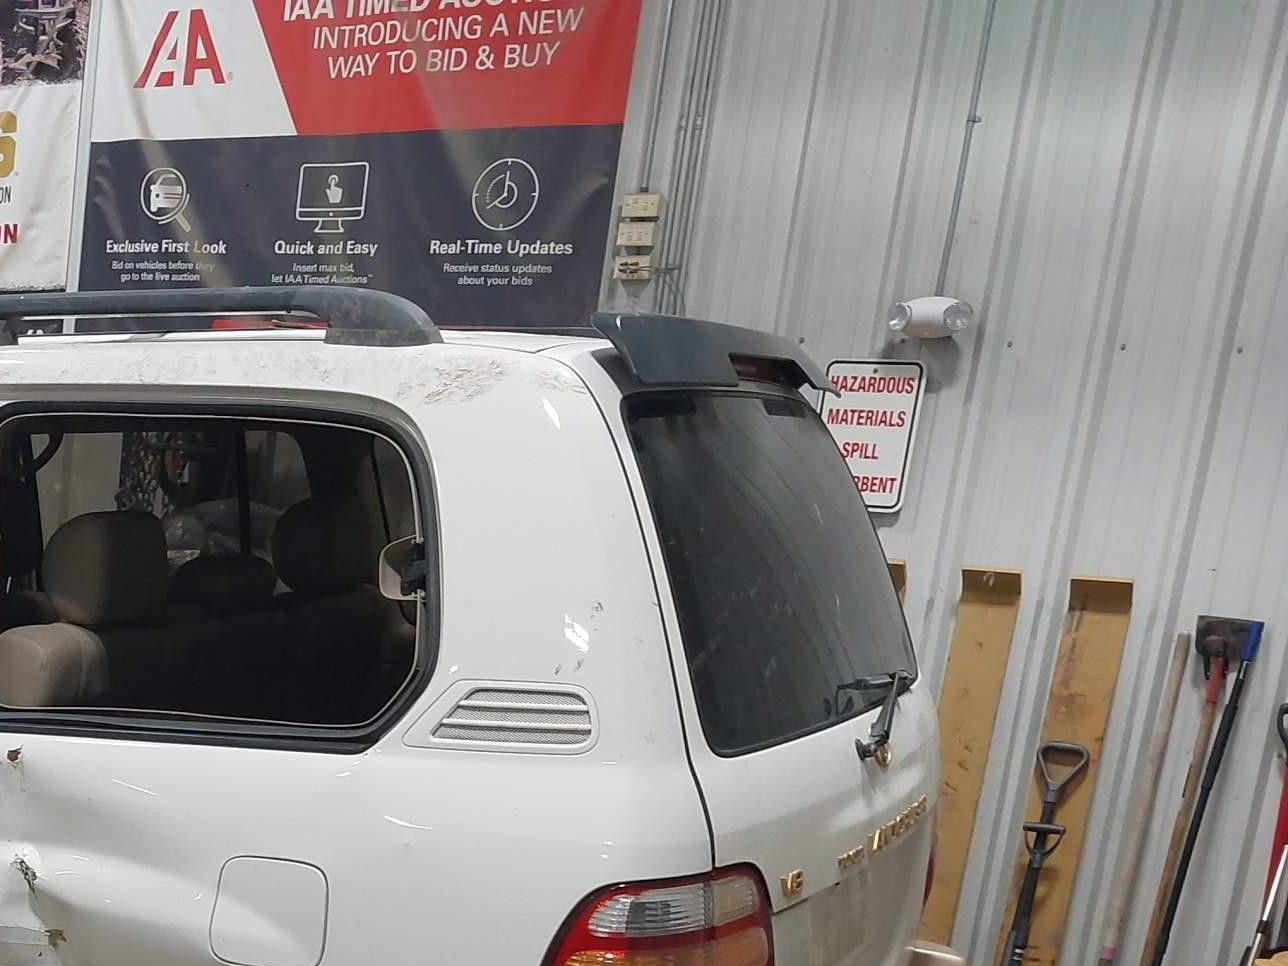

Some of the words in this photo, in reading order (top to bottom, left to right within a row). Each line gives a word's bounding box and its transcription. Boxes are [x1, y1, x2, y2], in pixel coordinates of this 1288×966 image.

[283, 0, 334, 21] IAA
[313, 14, 482, 50] INTRODUCING
[489, 20, 509, 37] A
[518, 7, 584, 35] NEW
[328, 52, 380, 79] WAY
[387, 49, 417, 75] TO
[425, 47, 468, 73] BID
[475, 45, 495, 71] &
[504, 41, 560, 69] BUY
[106, 240, 159, 254] Exclusive
[161, 239, 190, 253] First
[193, 240, 227, 255] Look
[274, 240, 314, 255] Quick
[317, 241, 344, 254] and
[346, 241, 378, 257] Easy
[429, 239, 502, 255] Real-Time
[507, 239, 573, 257] Updates
[135, 260, 168, 270] vehicles
[168, 260, 194, 270] before
[292, 262, 318, 273] Insert
[318, 264, 338, 273] max
[443, 262, 480, 274] Receive
[480, 263, 510, 274] status
[511, 264, 553, 275] updates
[120, 273, 131, 282] go
[132, 272, 140, 281] to
[141, 271, 153, 281] the
[155, 271, 170, 281] live
[171, 271, 201, 281] auction
[457, 275, 485, 286] about
[486, 278, 510, 288] your
[511, 275, 534, 287] bids
[830, 375, 915, 394] HAZARDOUS
[826, 408, 907, 428] MATERIALS
[842, 442, 879, 460] SPILL
